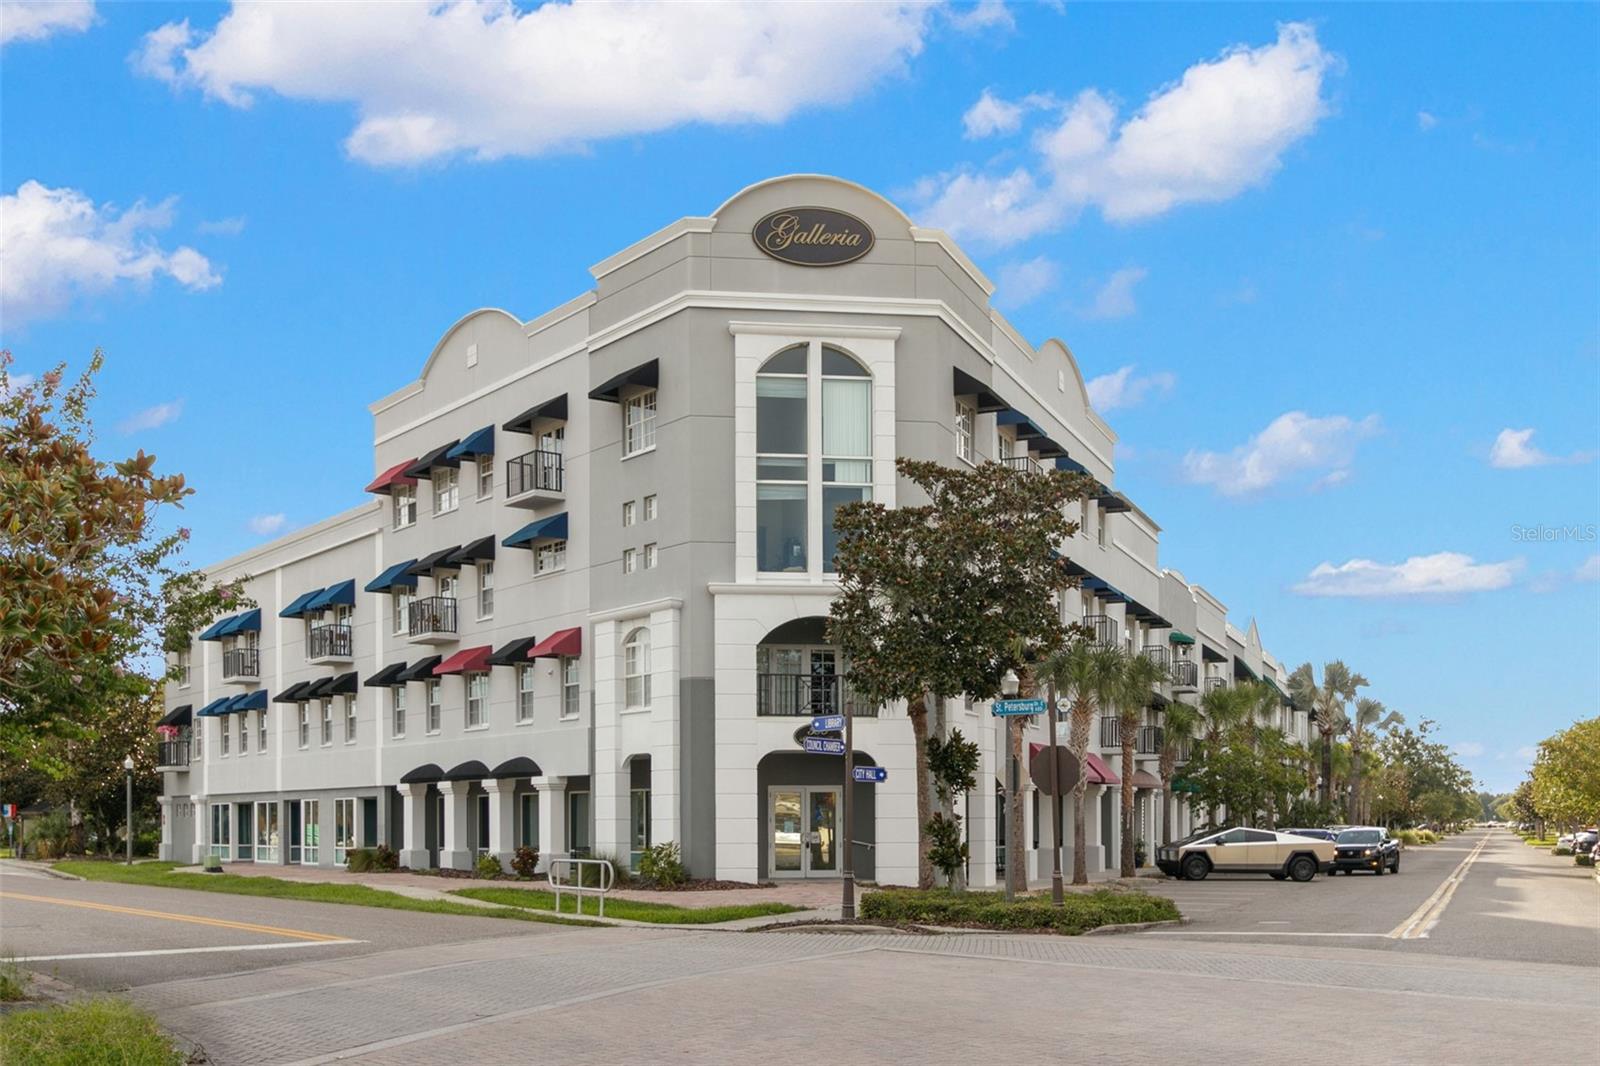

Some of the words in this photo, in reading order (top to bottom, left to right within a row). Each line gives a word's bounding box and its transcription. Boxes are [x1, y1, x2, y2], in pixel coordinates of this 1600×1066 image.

[765, 214, 862, 251] Galleria
[1004, 702, 1033, 713] Petersburg
[825, 718, 842, 729] LIBRARY
[806, 740, 822, 751] COUNCIL
[823, 741, 840, 752] CHAMBER
[855, 769, 865, 779] CITY
[867, 769, 877, 779] HALL
